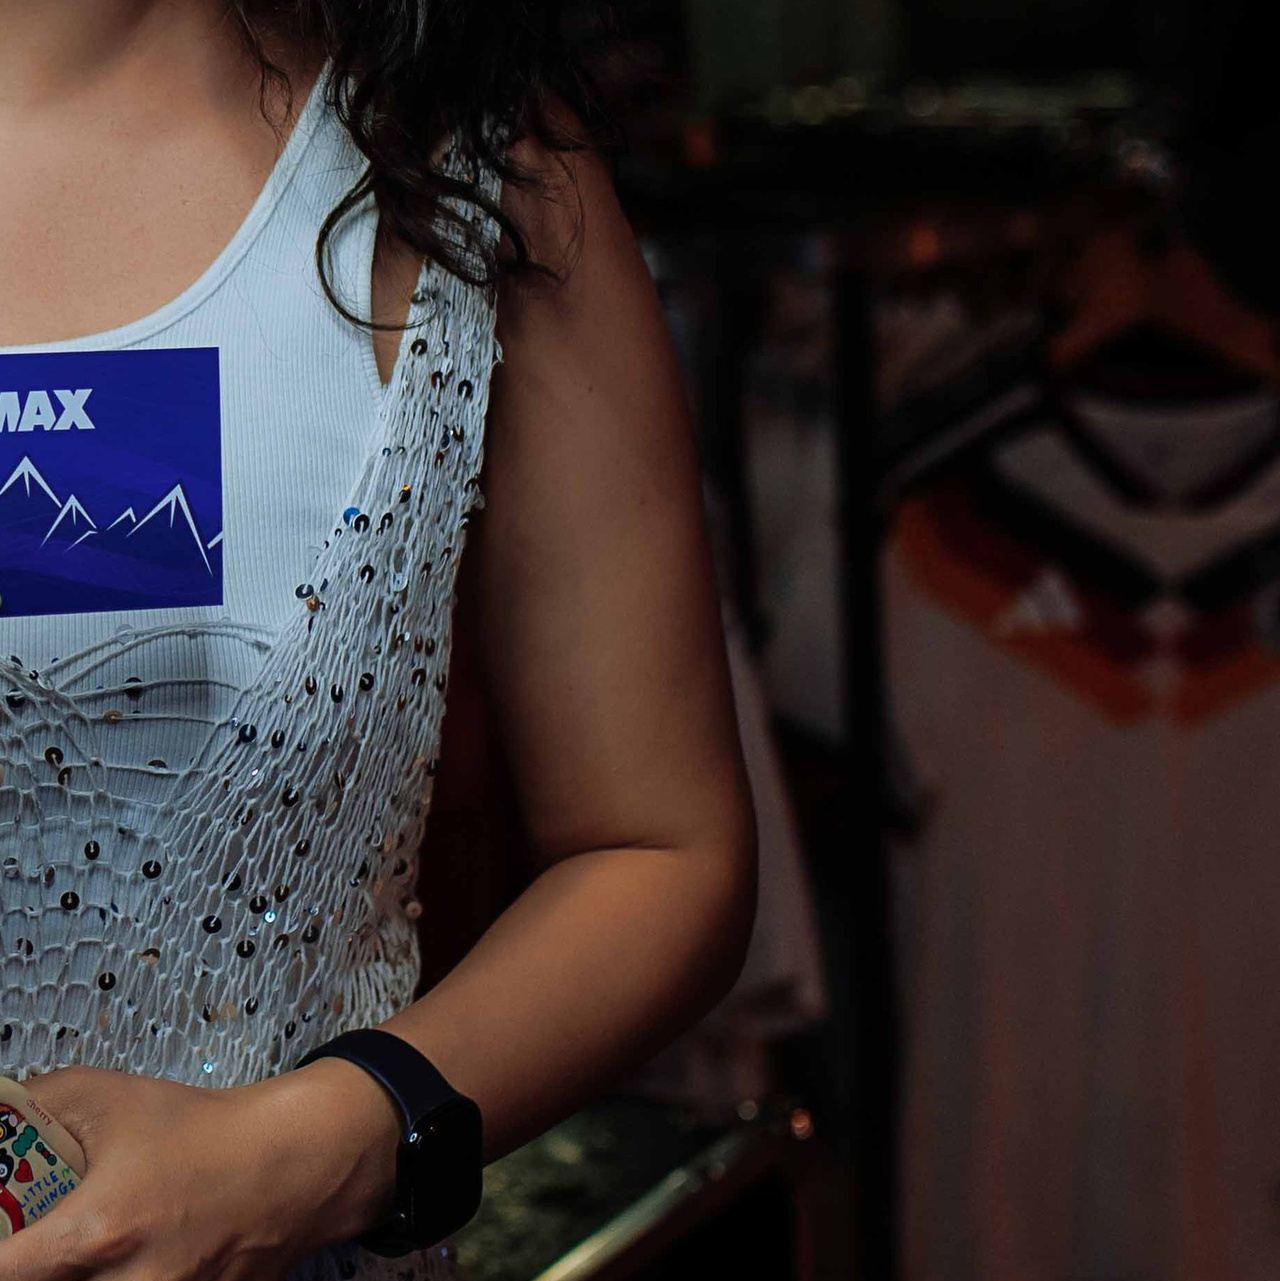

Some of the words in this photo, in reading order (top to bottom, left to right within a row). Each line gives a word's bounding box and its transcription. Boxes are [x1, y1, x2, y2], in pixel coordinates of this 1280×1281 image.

[26, 1098, 54, 1126] cherry
[18, 1170, 59, 1209] LITTLE
[28, 1179, 76, 1220] THINGS
